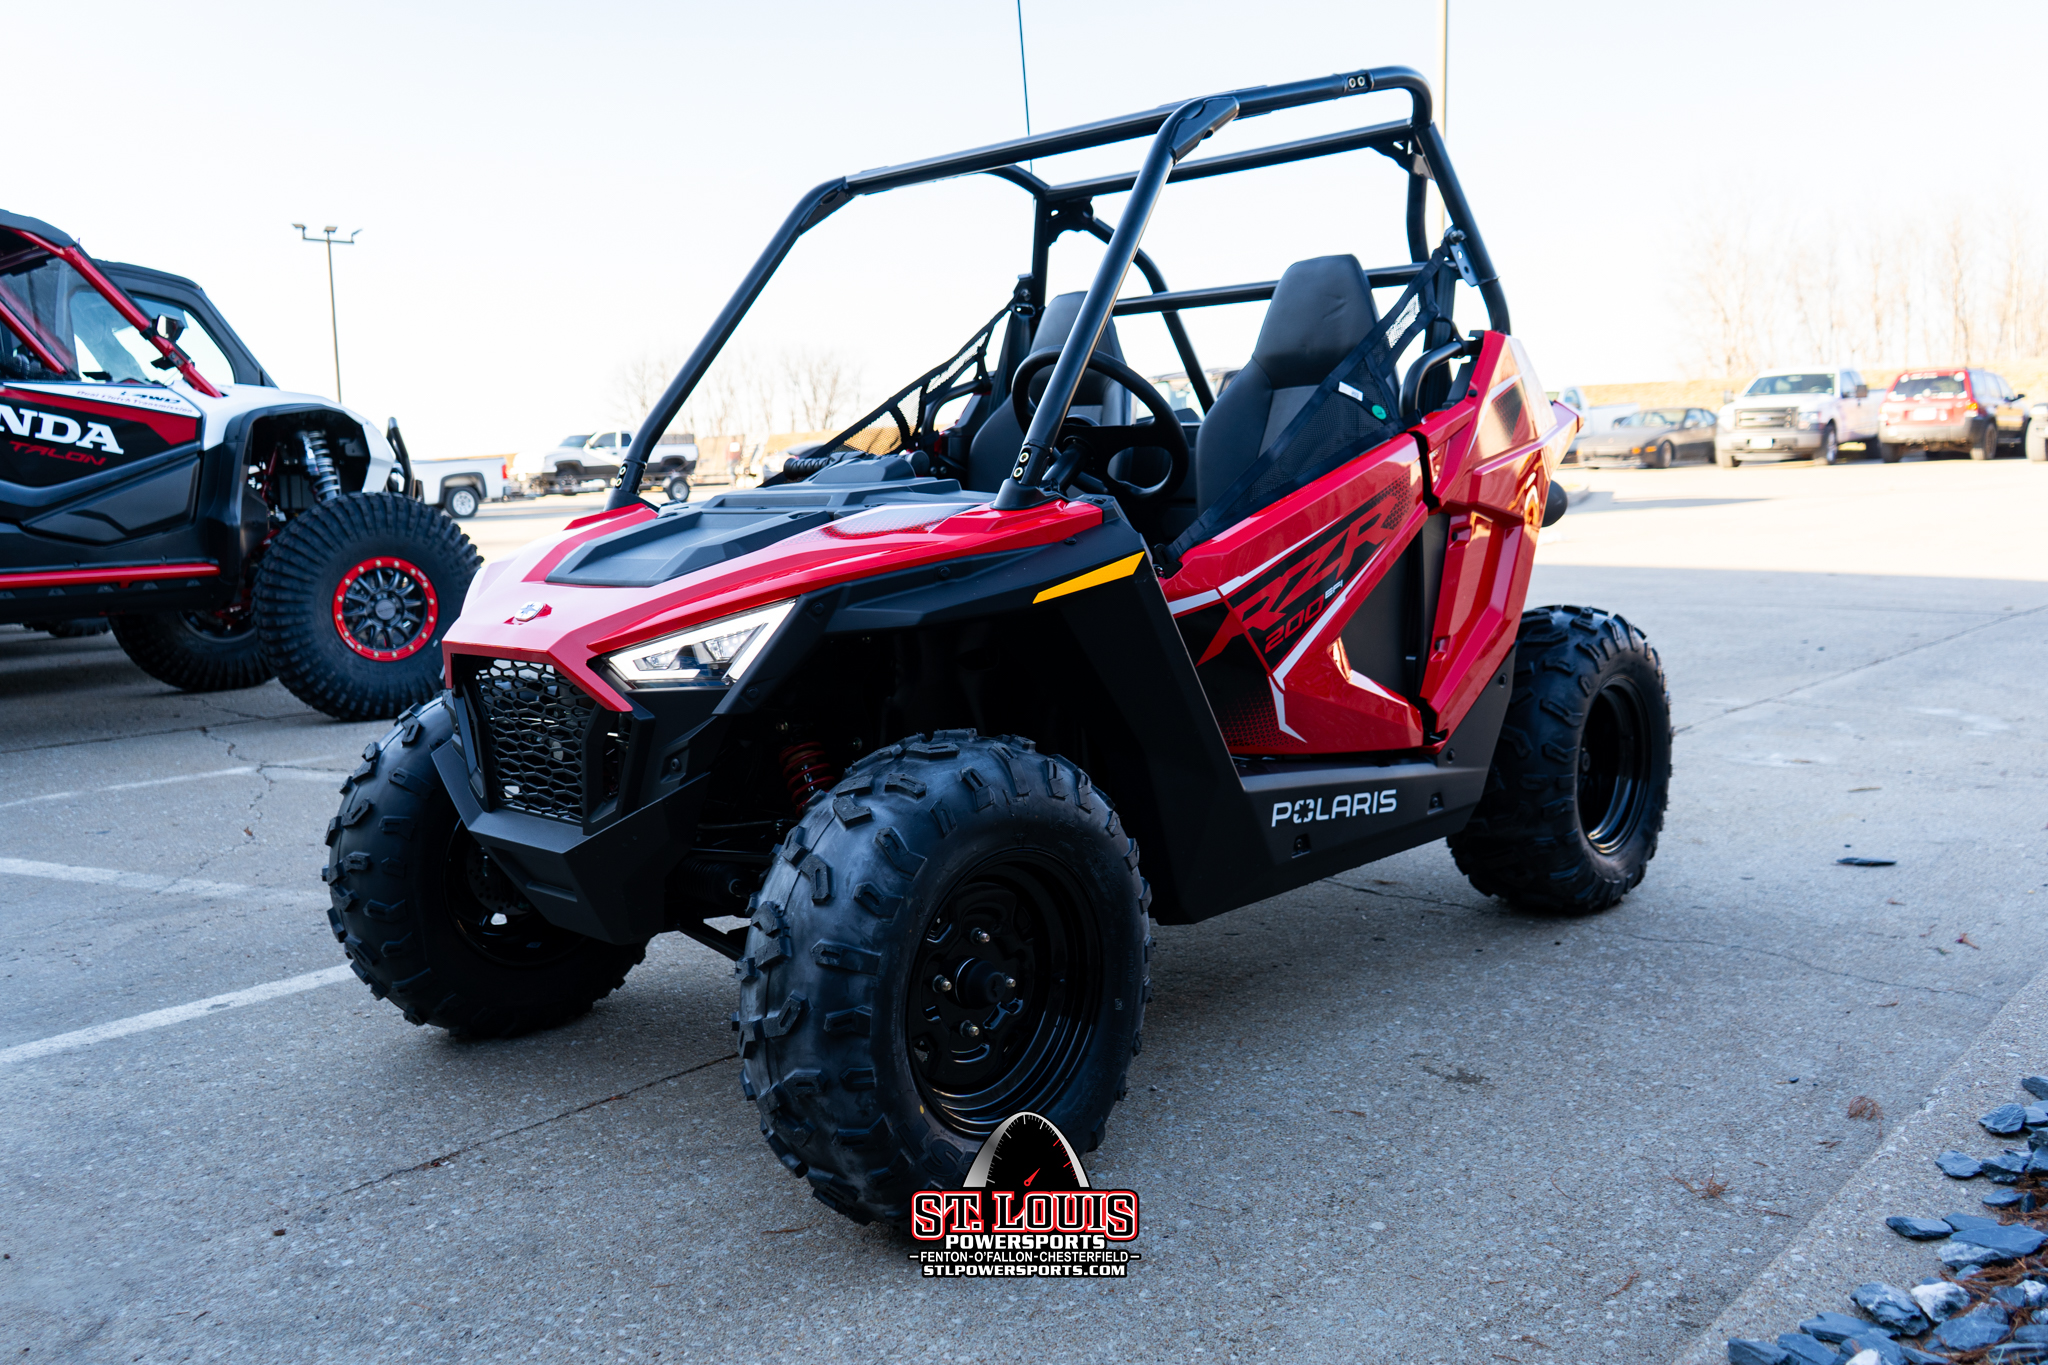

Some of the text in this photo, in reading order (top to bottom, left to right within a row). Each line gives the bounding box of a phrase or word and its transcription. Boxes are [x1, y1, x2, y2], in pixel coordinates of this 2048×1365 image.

[9, 440, 107, 466] TALON
[1196, 495, 1398, 668] RZR
[1265, 579, 1343, 654] 200 EFI
[1271, 789, 1397, 828] POLARIS
